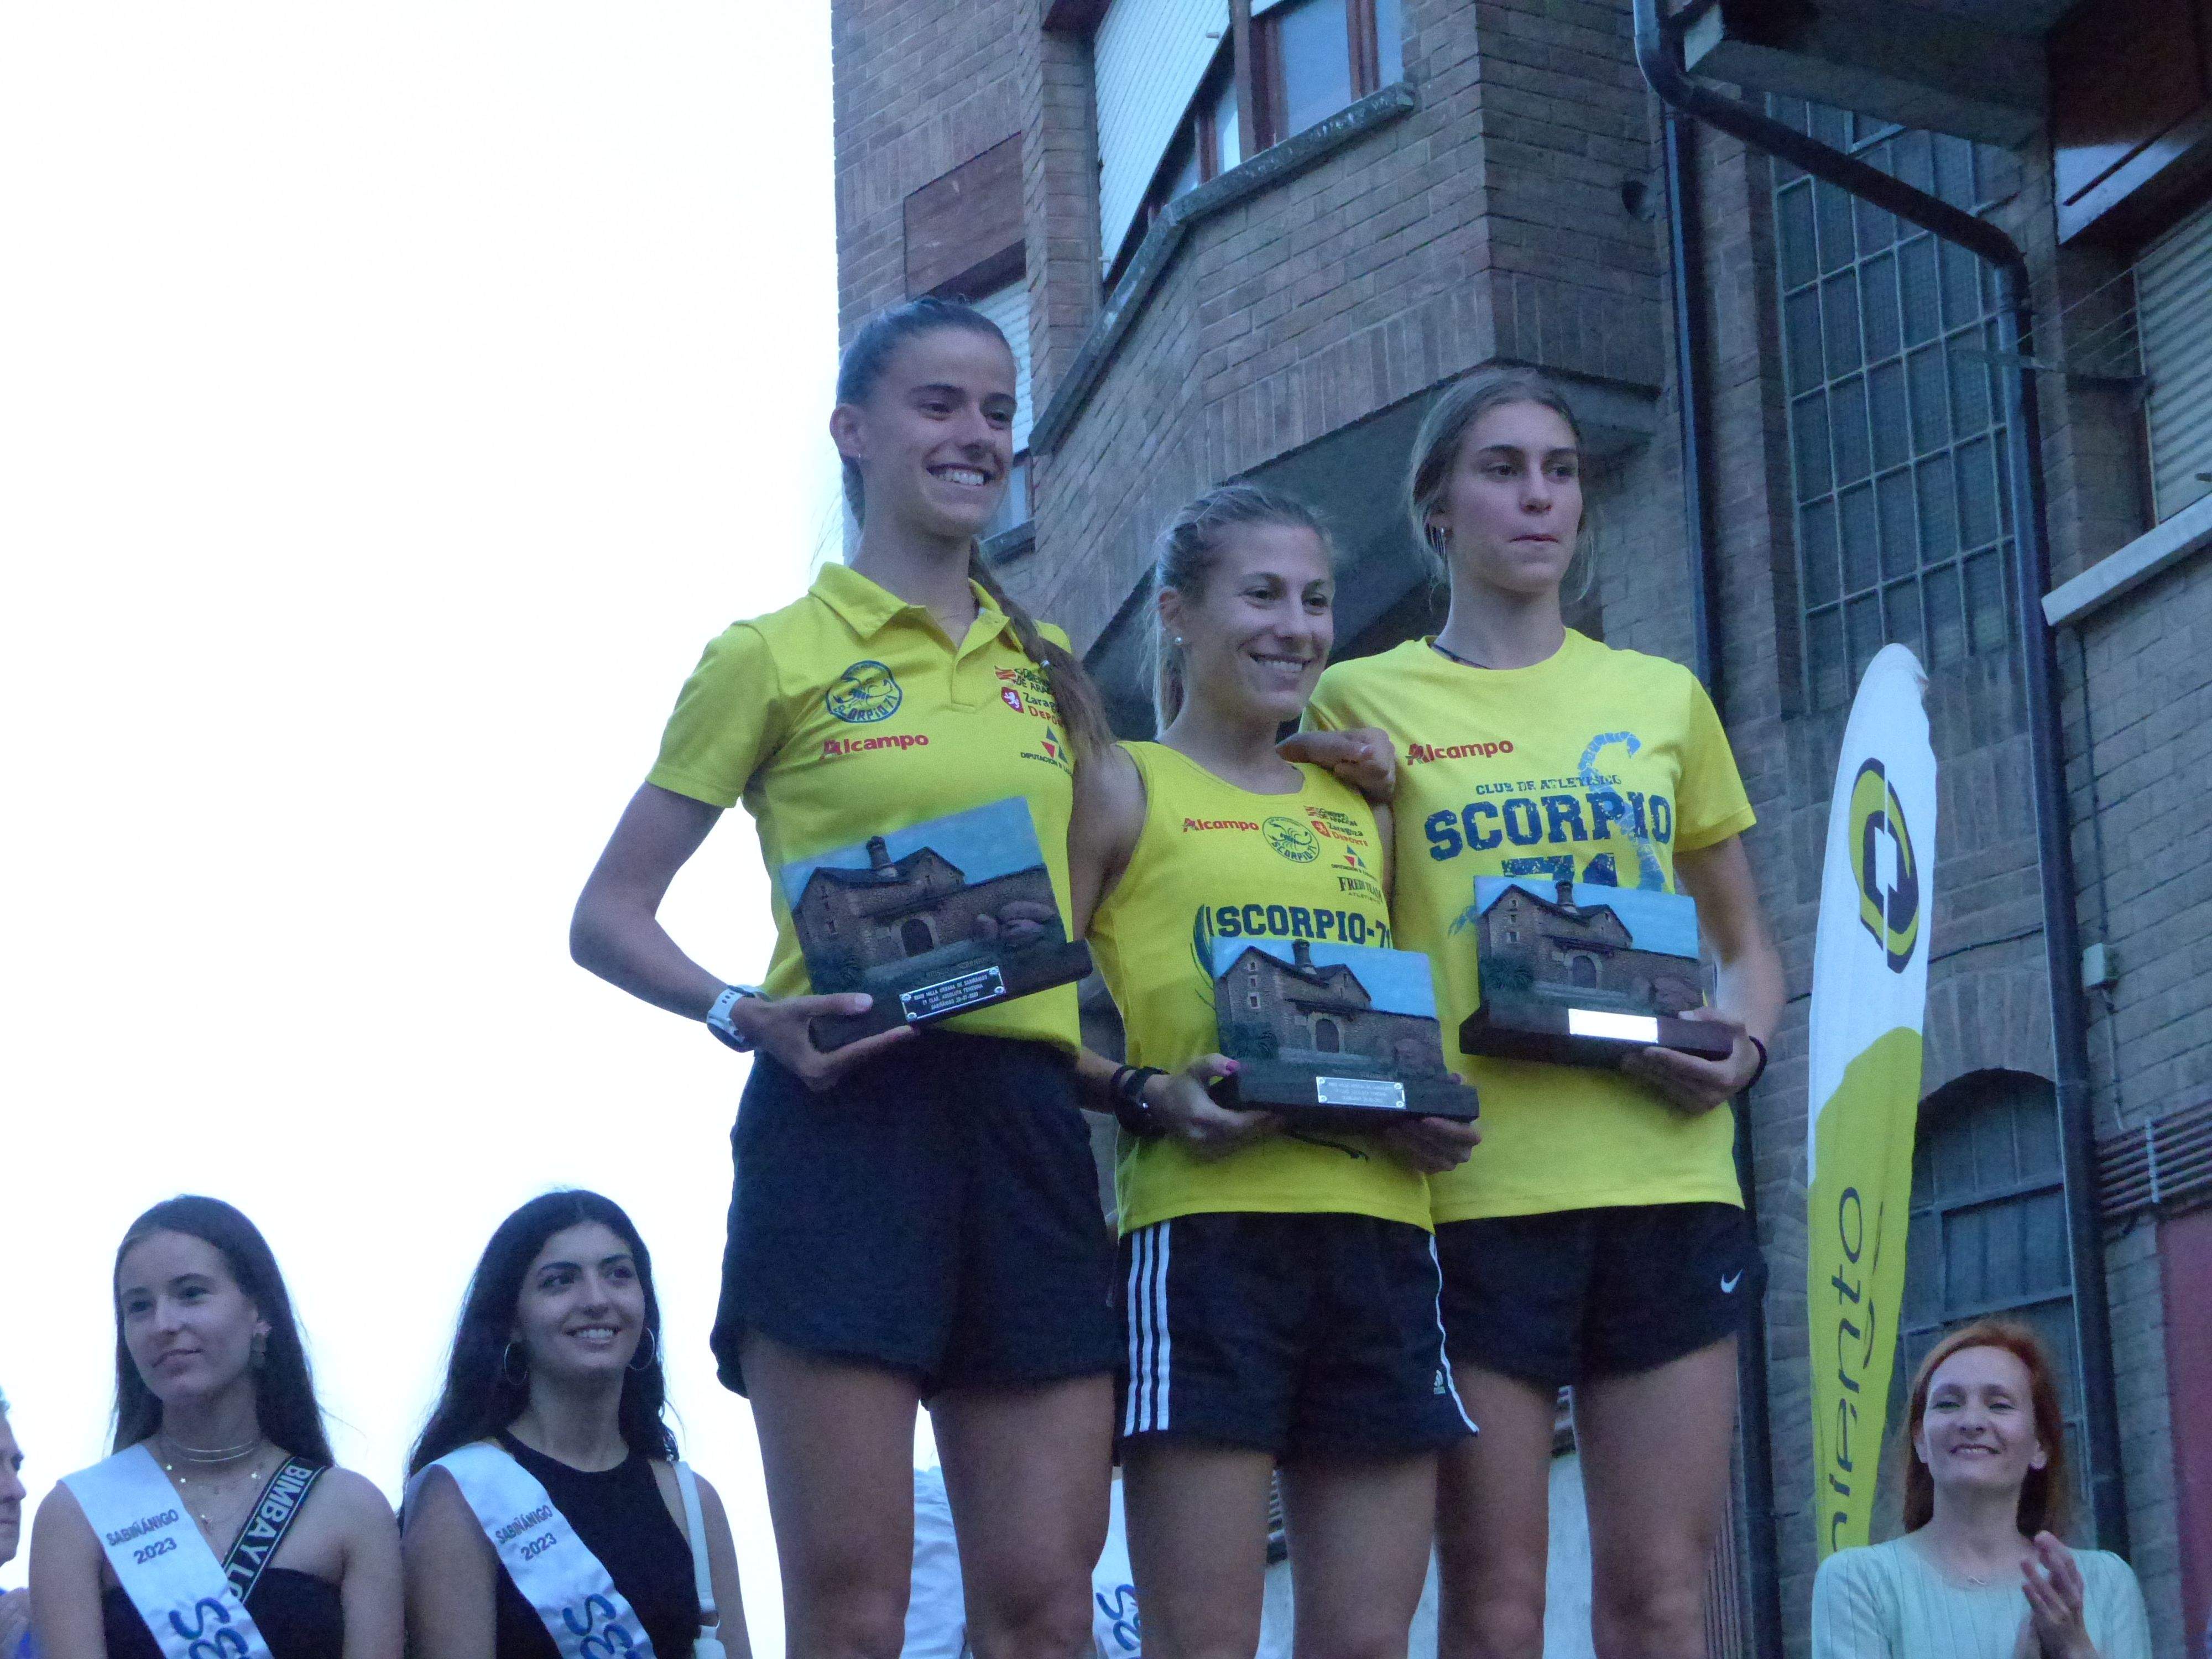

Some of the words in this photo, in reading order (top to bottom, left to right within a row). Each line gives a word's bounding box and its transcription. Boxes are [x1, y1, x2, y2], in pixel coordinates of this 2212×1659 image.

[1023, 692, 1057, 714] Zarag
[820, 734, 929, 760] Alcampo
[1406, 740, 1514, 766] Alcampo
[1476, 782, 1514, 795] CLUB
[1517, 780, 1536, 791] DE
[1182, 818, 1259, 832] Alcampo
[1424, 791, 1671, 861] SCORPIO
[247, 1465, 313, 1537] BIMBA
[106, 1509, 179, 1546] SABIÑÁNIGO
[495, 1505, 552, 1545] SABIÑÁNIGO
[134, 1537, 176, 1564] 2023
[521, 1532, 557, 1561] 2023
